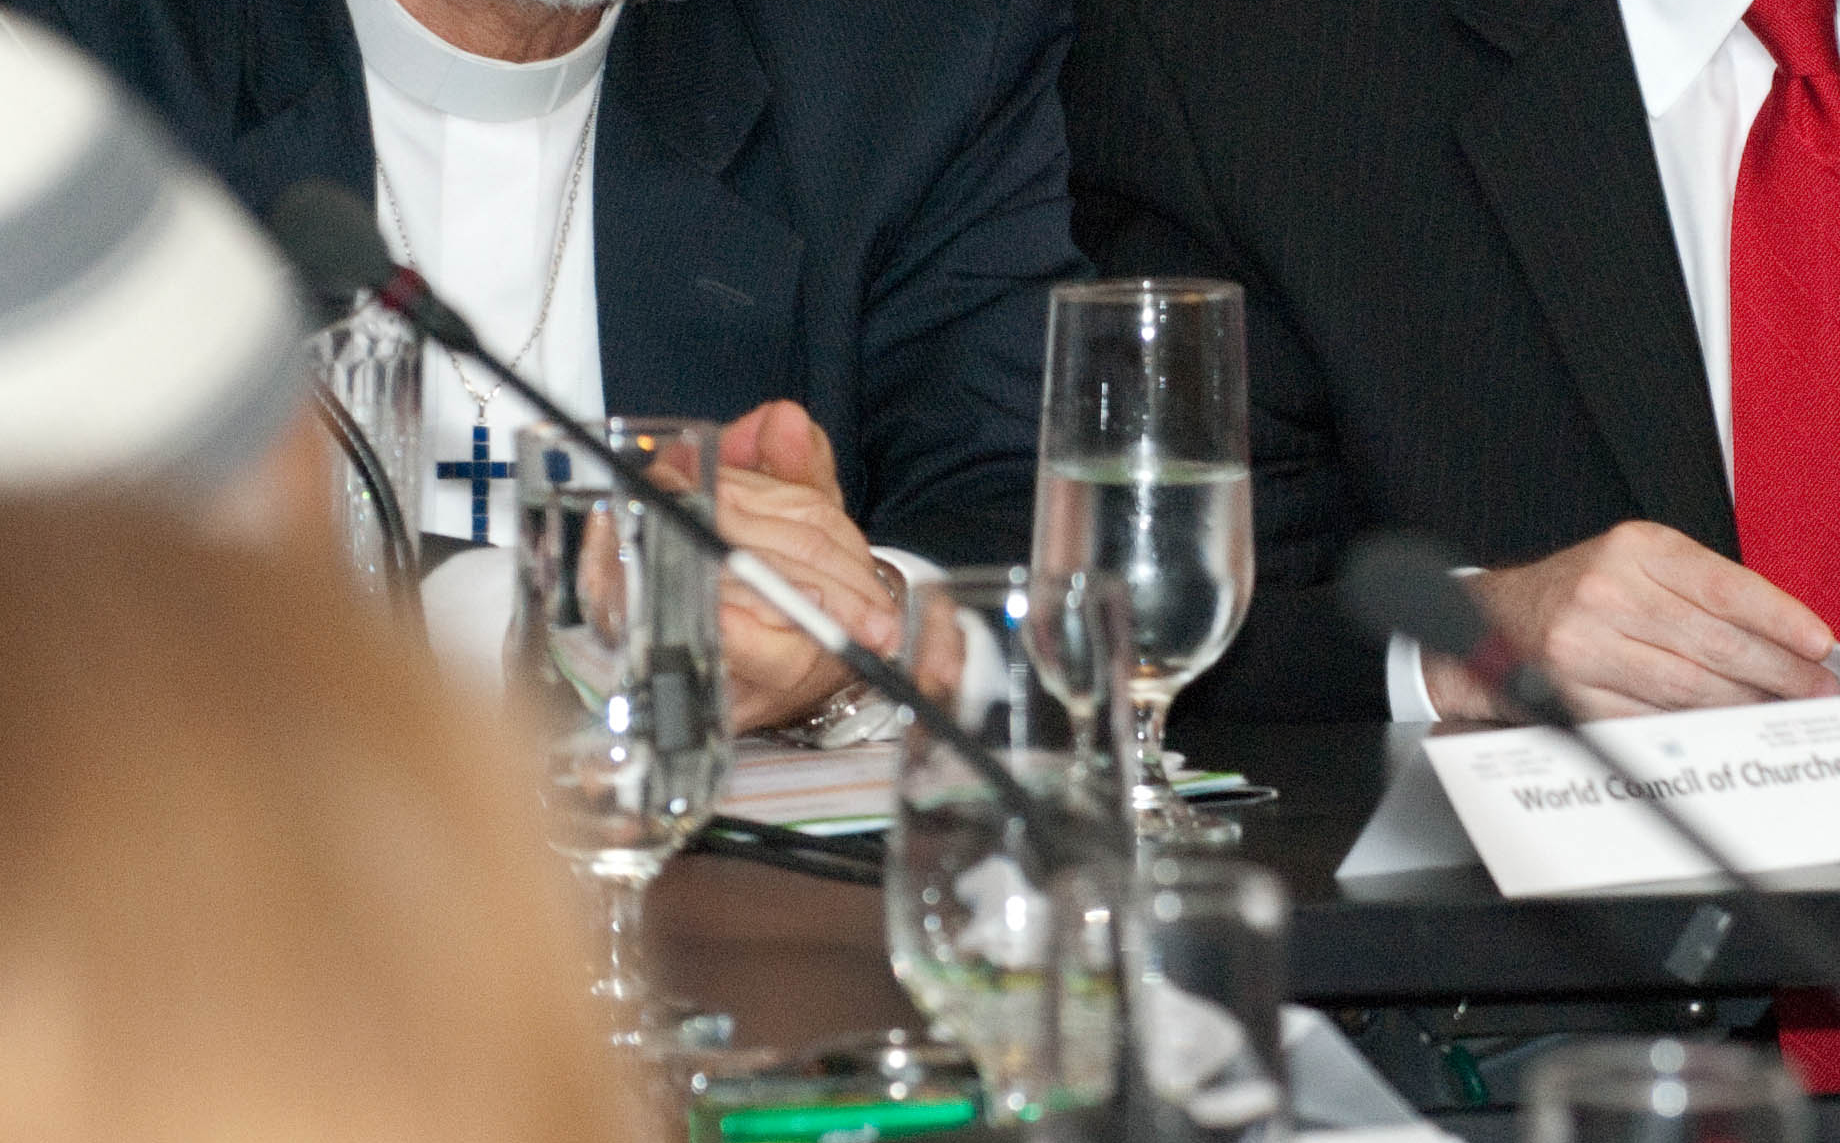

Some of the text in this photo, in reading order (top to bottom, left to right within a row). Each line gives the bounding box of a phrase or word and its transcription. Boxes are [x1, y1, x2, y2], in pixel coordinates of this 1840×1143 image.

[1512, 778, 1601, 811] World
[1604, 769, 1702, 801] Council
[1706, 763, 1737, 791] of
